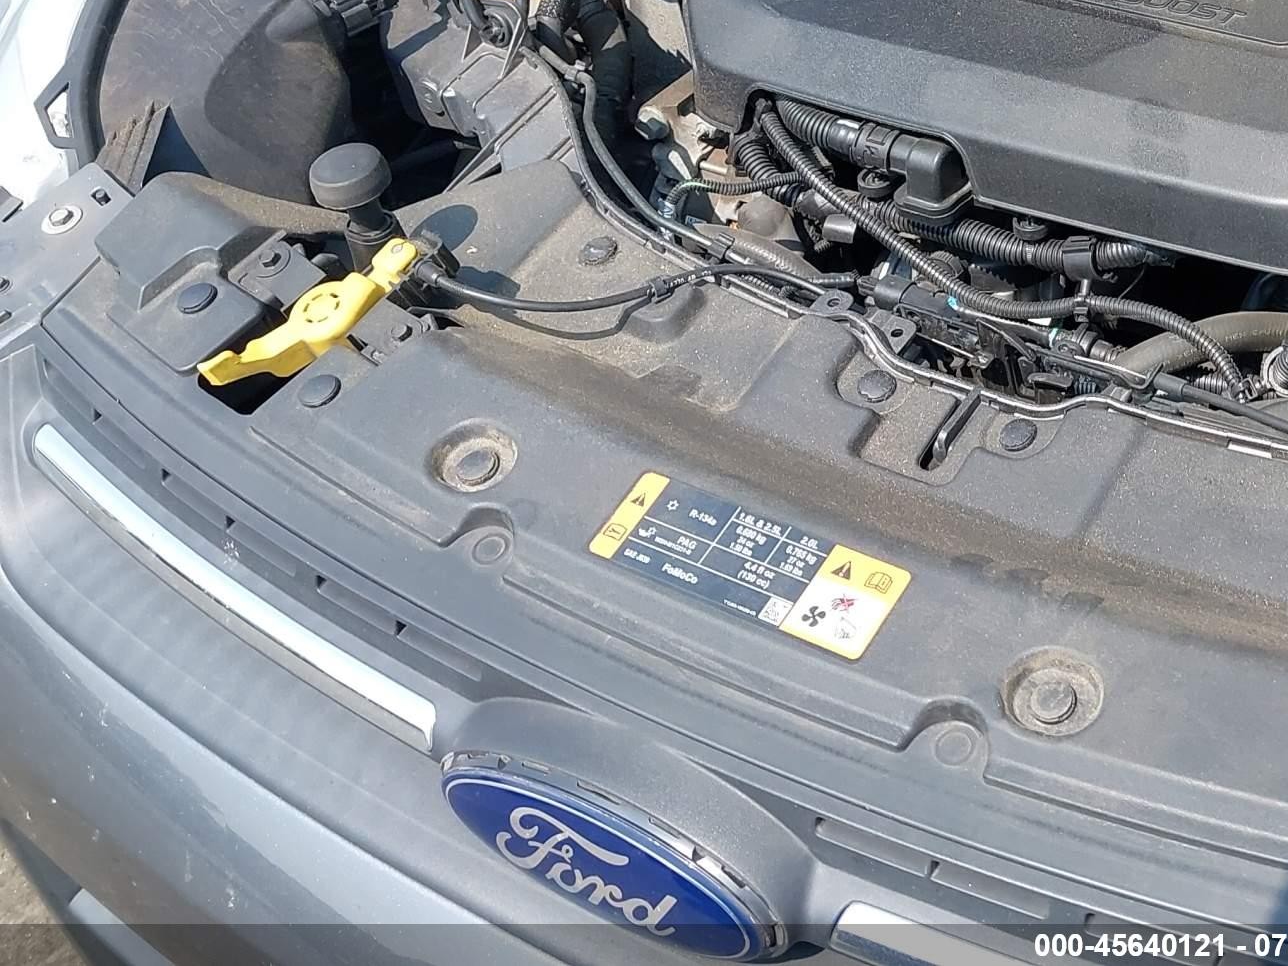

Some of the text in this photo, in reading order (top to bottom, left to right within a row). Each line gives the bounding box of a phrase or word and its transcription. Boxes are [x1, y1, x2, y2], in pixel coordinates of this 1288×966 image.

[688, 508, 718, 526] R-134a
[739, 512, 756, 525] 1.6L
[677, 535, 698, 550] PAG
[755, 533, 767, 545] kg
[800, 535, 819, 550] 2.0L
[805, 553, 818, 566] kg
[661, 562, 699, 584] FoMoCo
[495, 806, 678, 937] Ford
